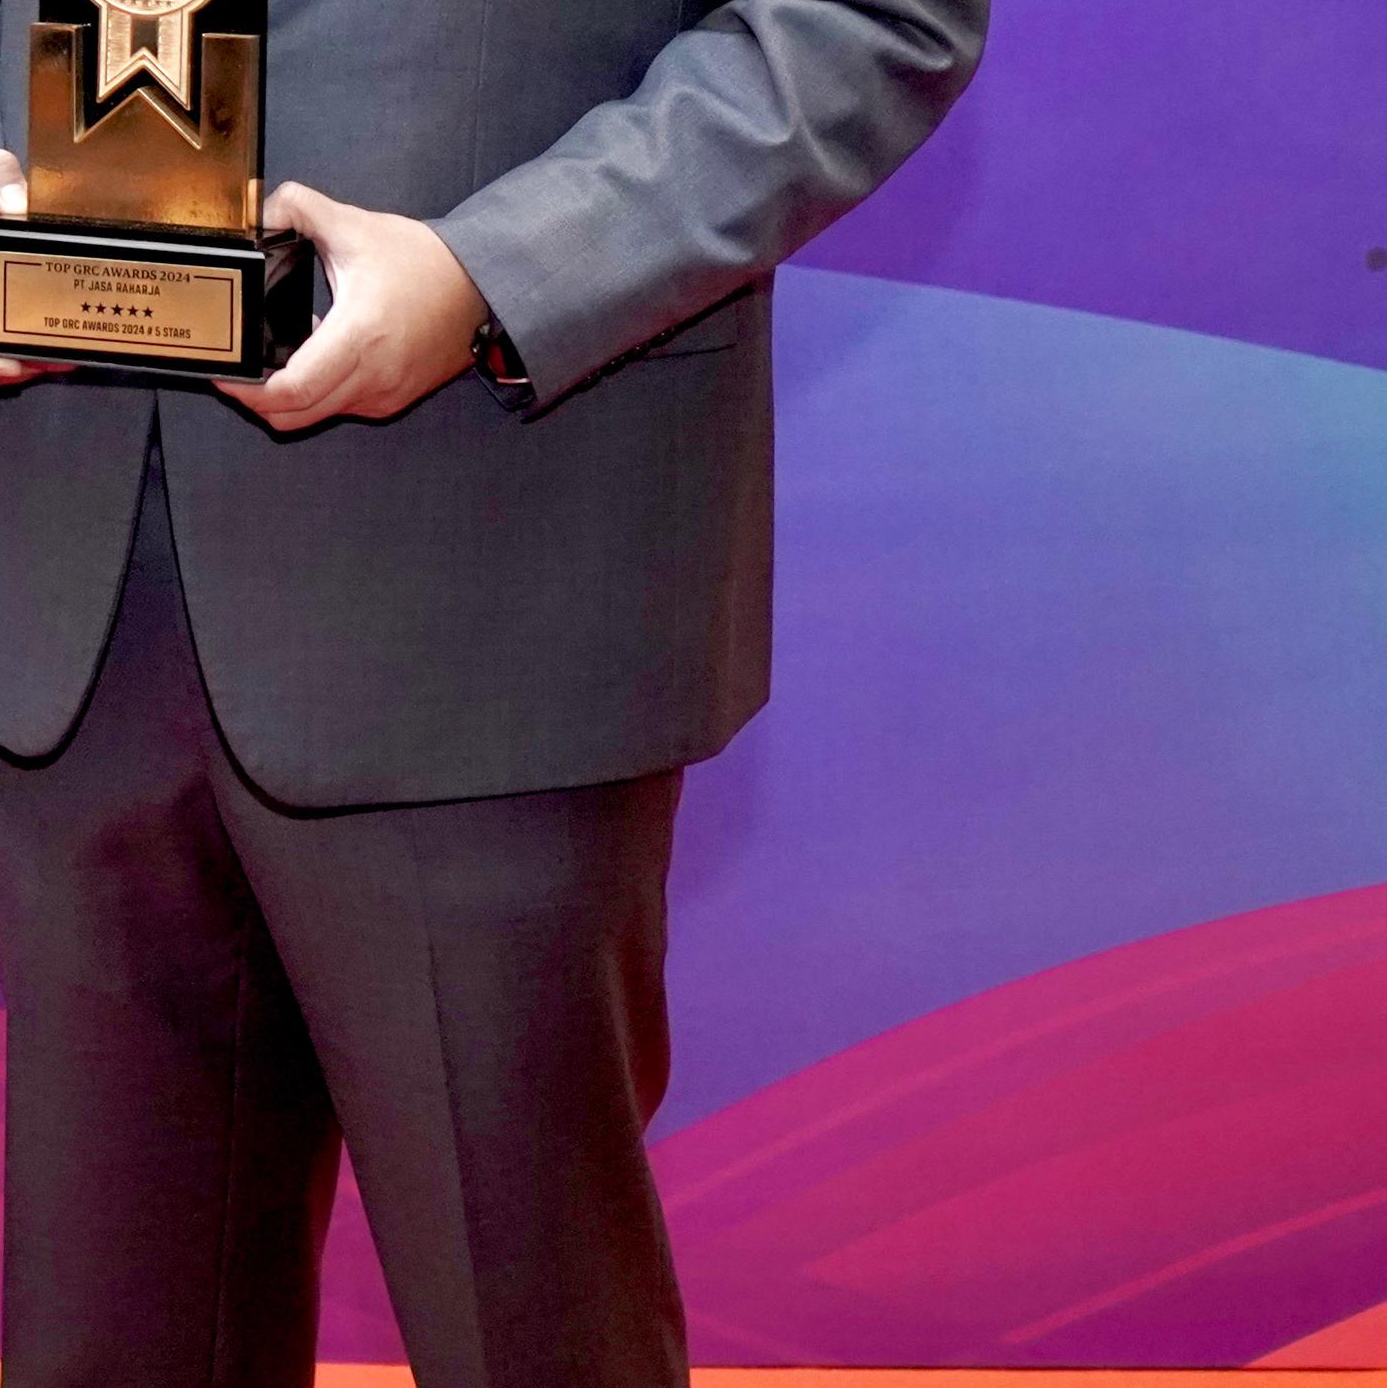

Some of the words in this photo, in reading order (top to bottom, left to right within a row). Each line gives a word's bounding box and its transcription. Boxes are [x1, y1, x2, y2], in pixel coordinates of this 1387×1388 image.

[45, 262, 70, 273] TOP
[74, 264, 100, 276] GRC
[102, 267, 157, 280] AWARDS
[160, 271, 190, 283] 2024
[74, 279, 84, 290] PT
[89, 280, 112, 292] JASA
[116, 282, 160, 295] RAHARJA
[44, 317, 60, 327] TOP
[62, 318, 79, 329] GRC
[82, 320, 119, 333] AWARDS
[122, 323, 144, 335] 2024
[156, 326, 161, 336] 5
[164, 327, 191, 339] STARS
